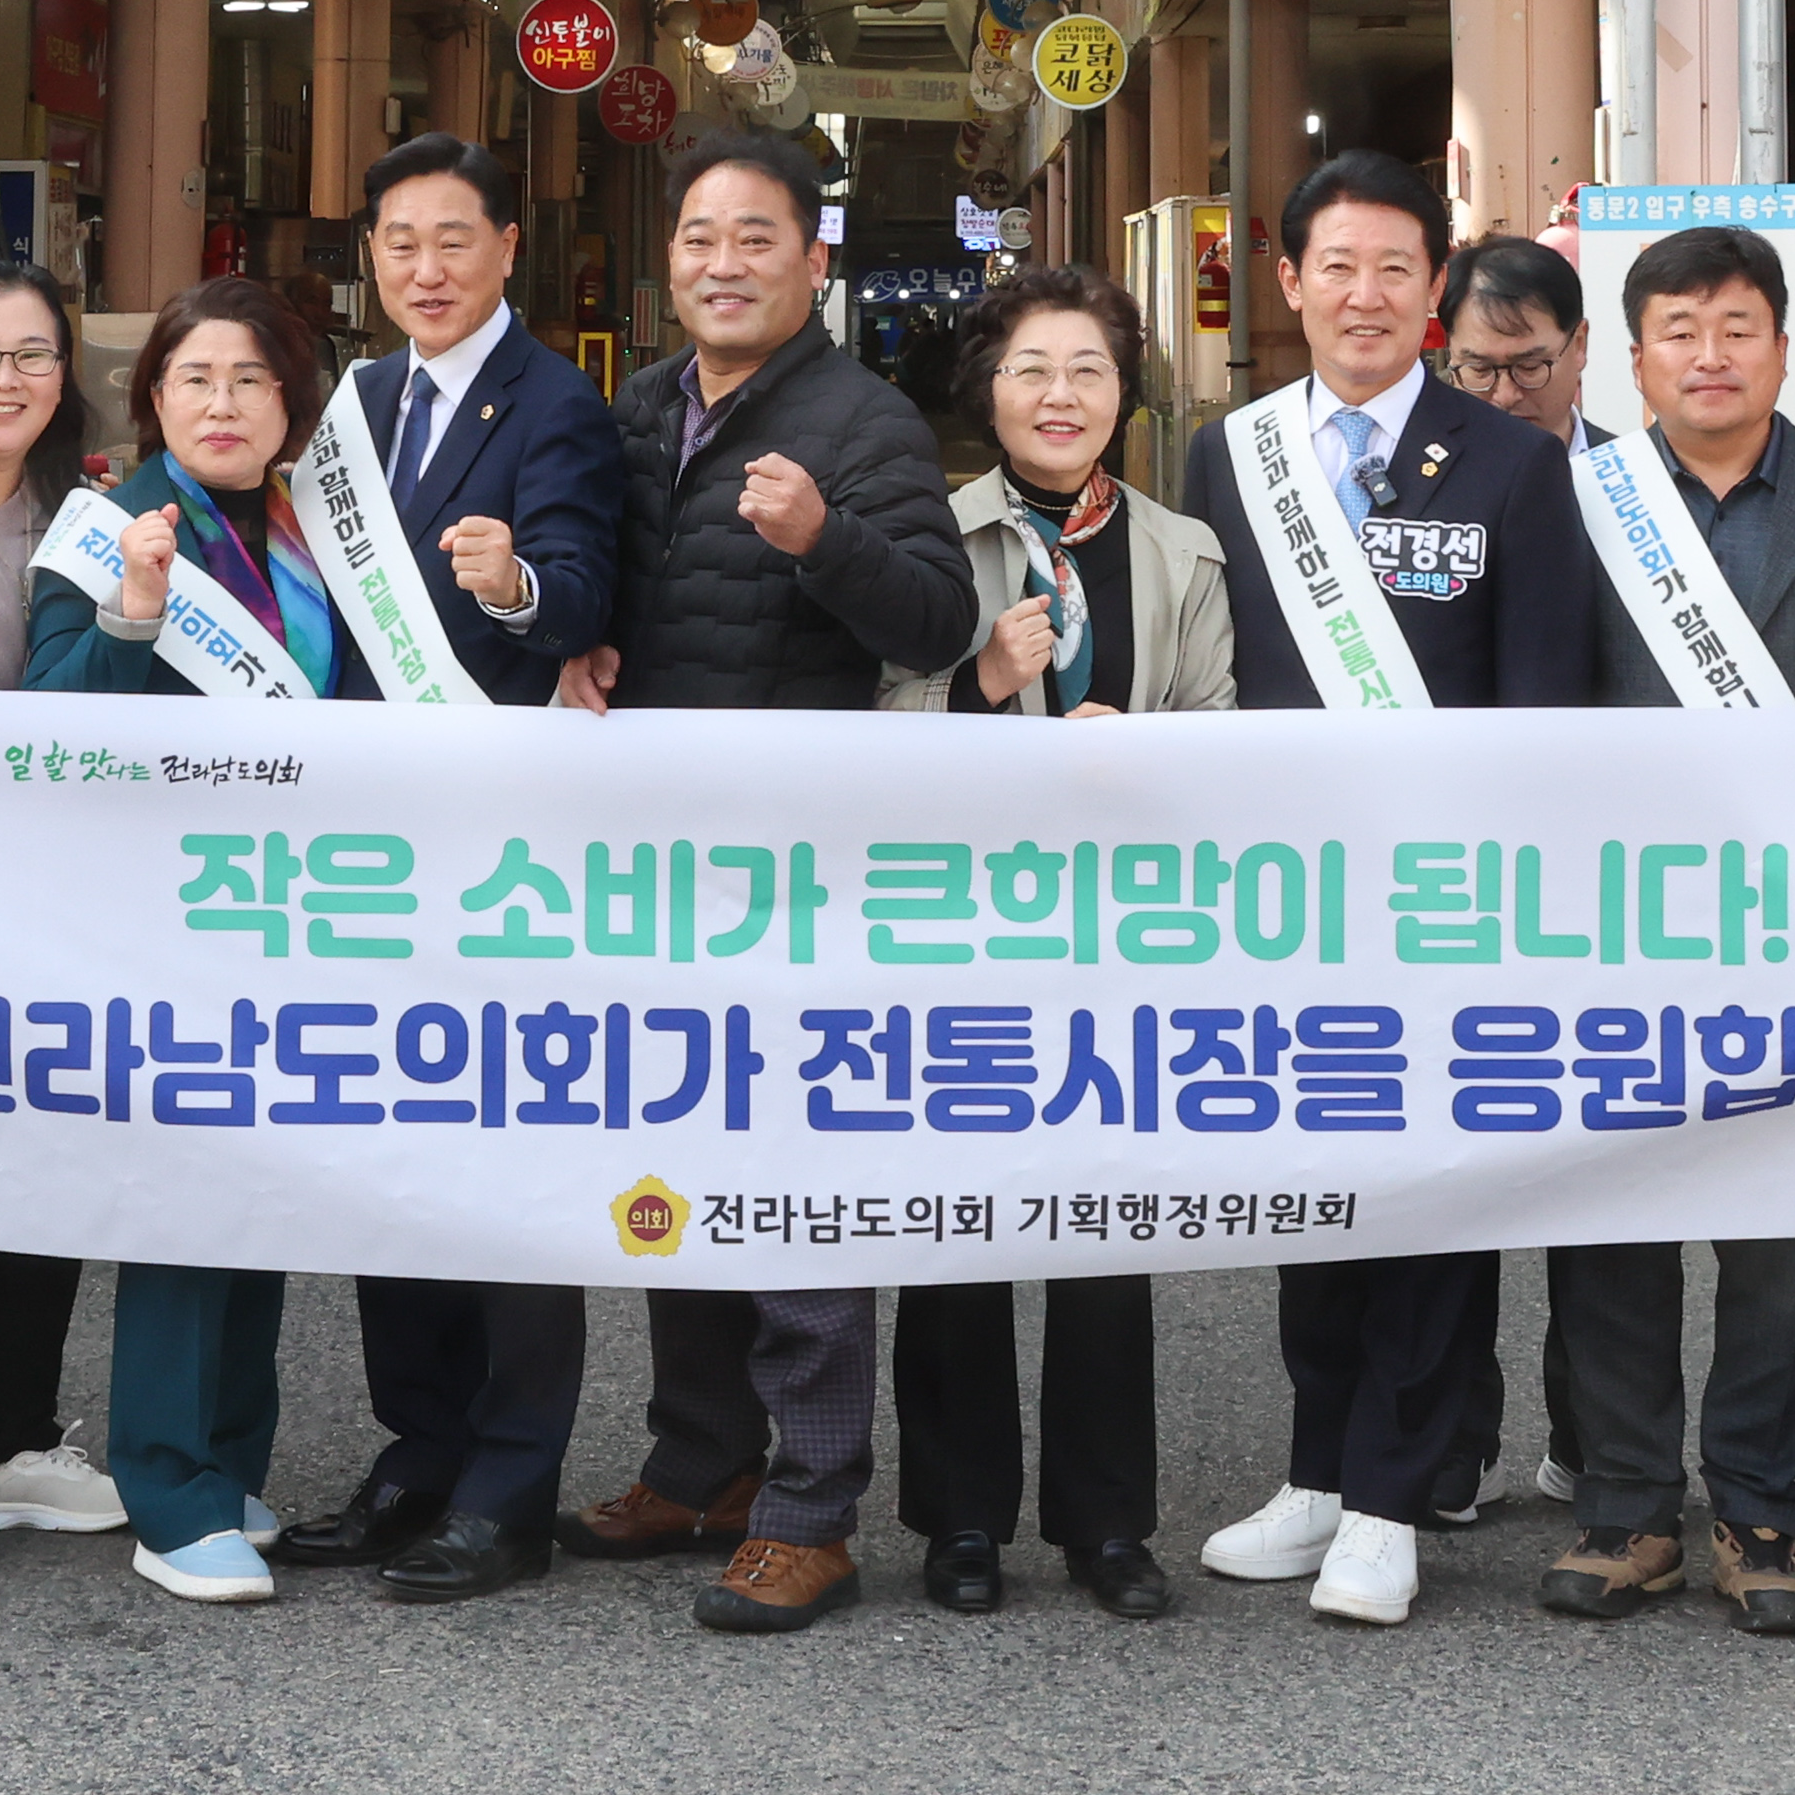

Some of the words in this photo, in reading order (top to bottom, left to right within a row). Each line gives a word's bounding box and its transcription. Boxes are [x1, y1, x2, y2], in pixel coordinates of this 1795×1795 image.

[525, 13, 611, 48] 신토불이
[532, 47, 597, 71] 아구찜
[1587, 194, 1640, 221] 동문2
[1645, 194, 1685, 221] 입구
[1692, 194, 1732, 220] 우측
[908, 267, 986, 295] 오늘수
[1253, 408, 1291, 491] 도민과
[1273, 488, 1345, 610] 함께하는
[1324, 608, 1402, 708] 전통시
[1363, 523, 1483, 577] 전경선
[317, 465, 376, 570] 함께하는
[358, 566, 427, 686] 전통시장
[1394, 570, 1451, 594] 도의원
[160, 754, 304, 788] 전라남도의회
[178, 830, 419, 962] 작은
[454, 836, 829, 965] 소비가
[860, 839, 1345, 967] 큰희망이
[1387, 838, 1790, 966] 됩니다!
[798, 1004, 1407, 1134] 전통시장을
[629, 1209, 670, 1231] 의회
[700, 1193, 996, 1245] 전라남도의회
[1017, 1191, 1358, 1242] 기획행정위원회
